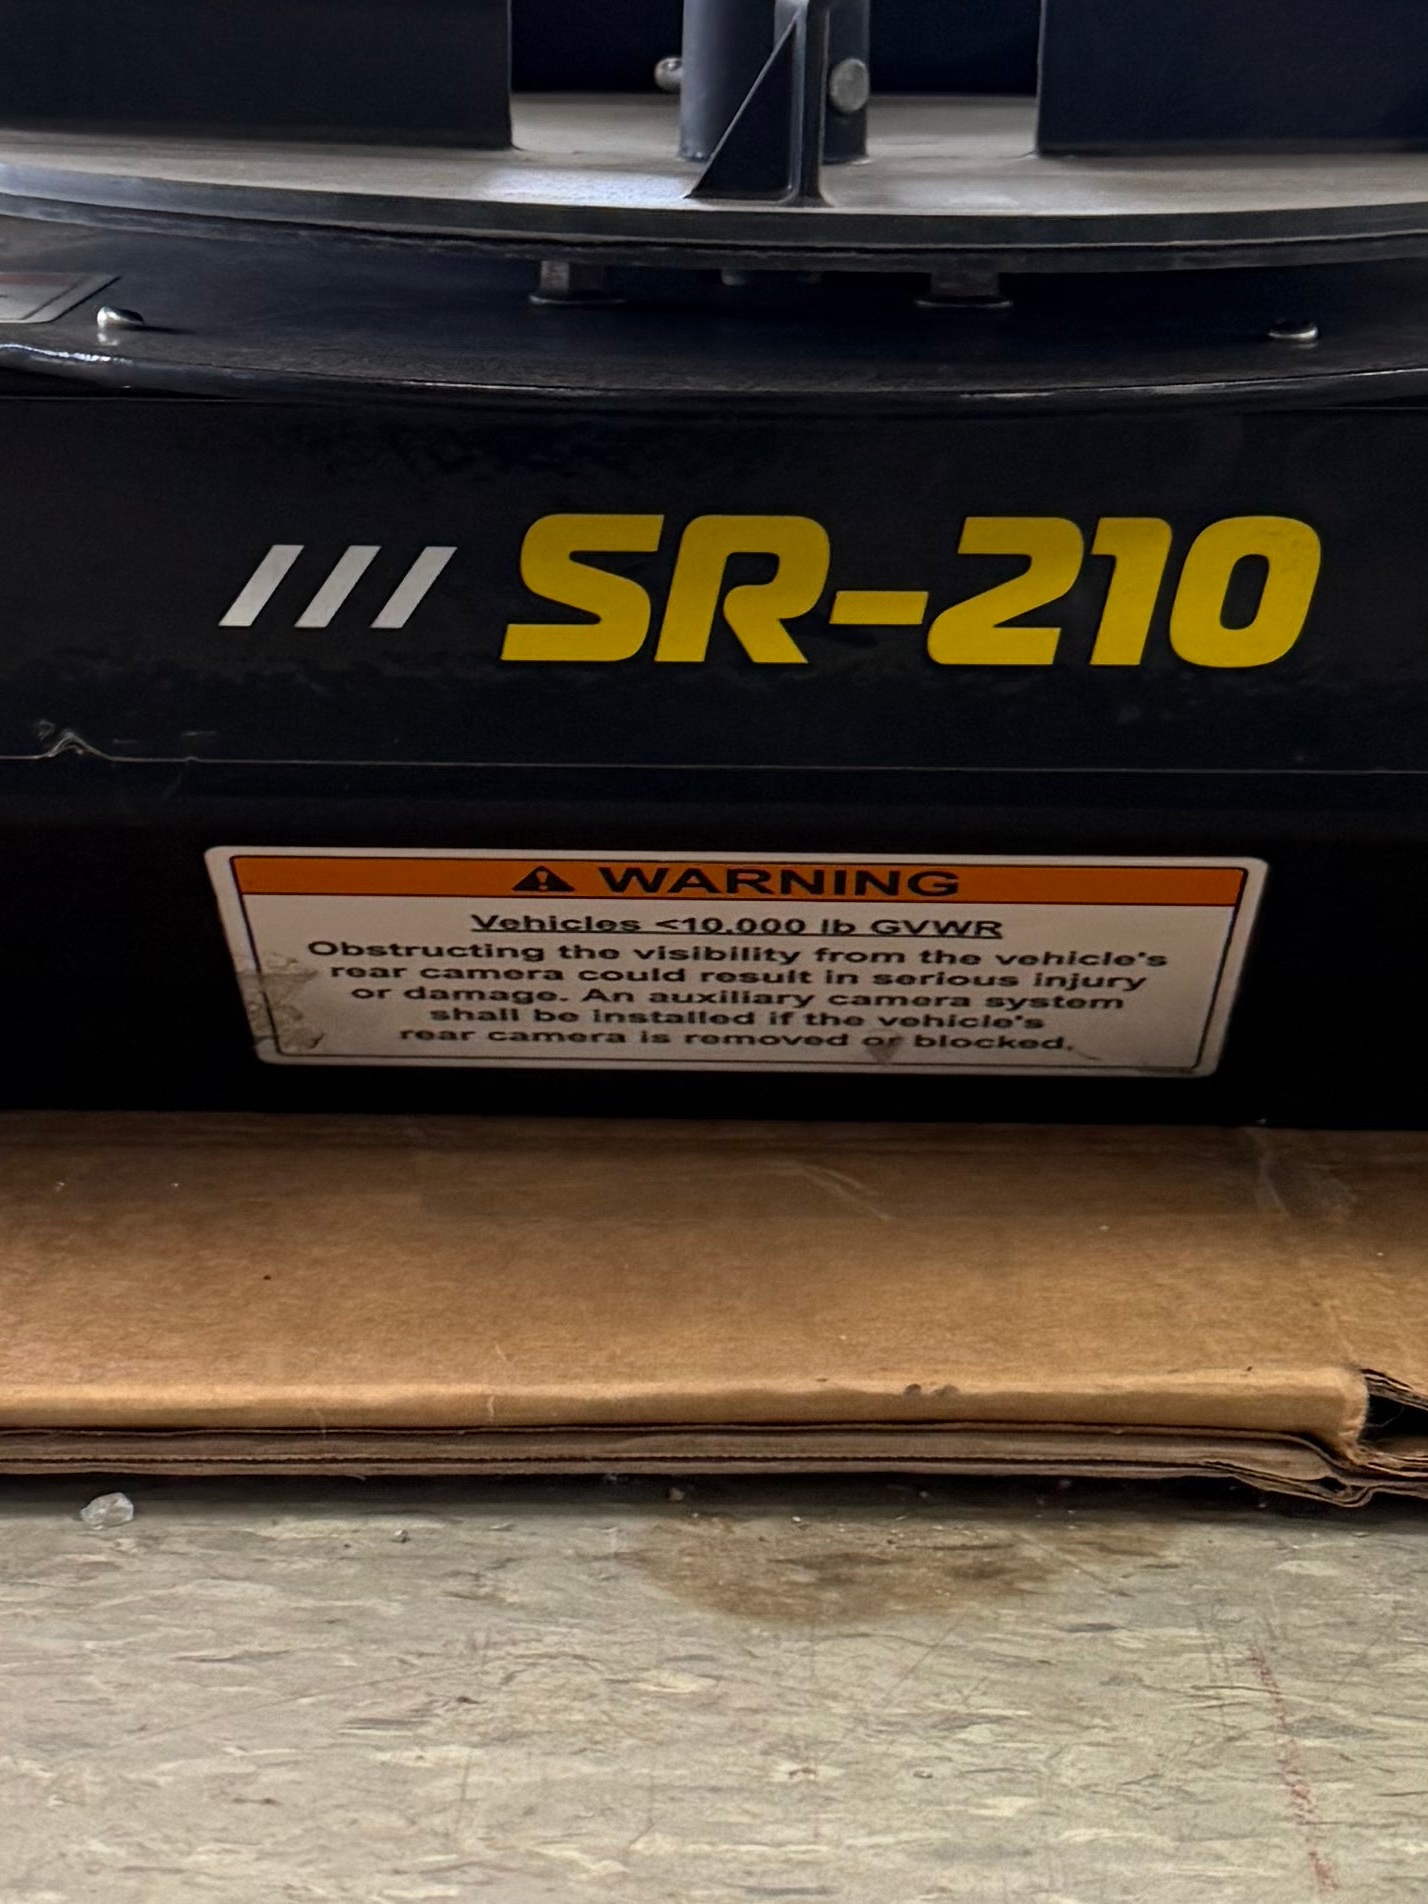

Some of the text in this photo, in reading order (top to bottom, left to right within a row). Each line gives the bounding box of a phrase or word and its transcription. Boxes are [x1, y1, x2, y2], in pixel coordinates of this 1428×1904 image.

[500, 513, 1321, 668] SR-210
[599, 867, 959, 896] WARNING
[471, 915, 641, 931] Vehicles
[821, 919, 855, 935] lb
[872, 919, 1002, 936] GVWR
[308, 940, 1168, 967] Obstructing the visibility from the vehicle's
[330, 966, 1146, 992] rear camera could result in serious injury
[352, 986, 1123, 1012] or damage. An auxiliary camera system
[430, 1008, 1044, 1029] shall be installed if the vehicle's
[400, 1030, 1074, 1050] rear camera is removed or blocked.
